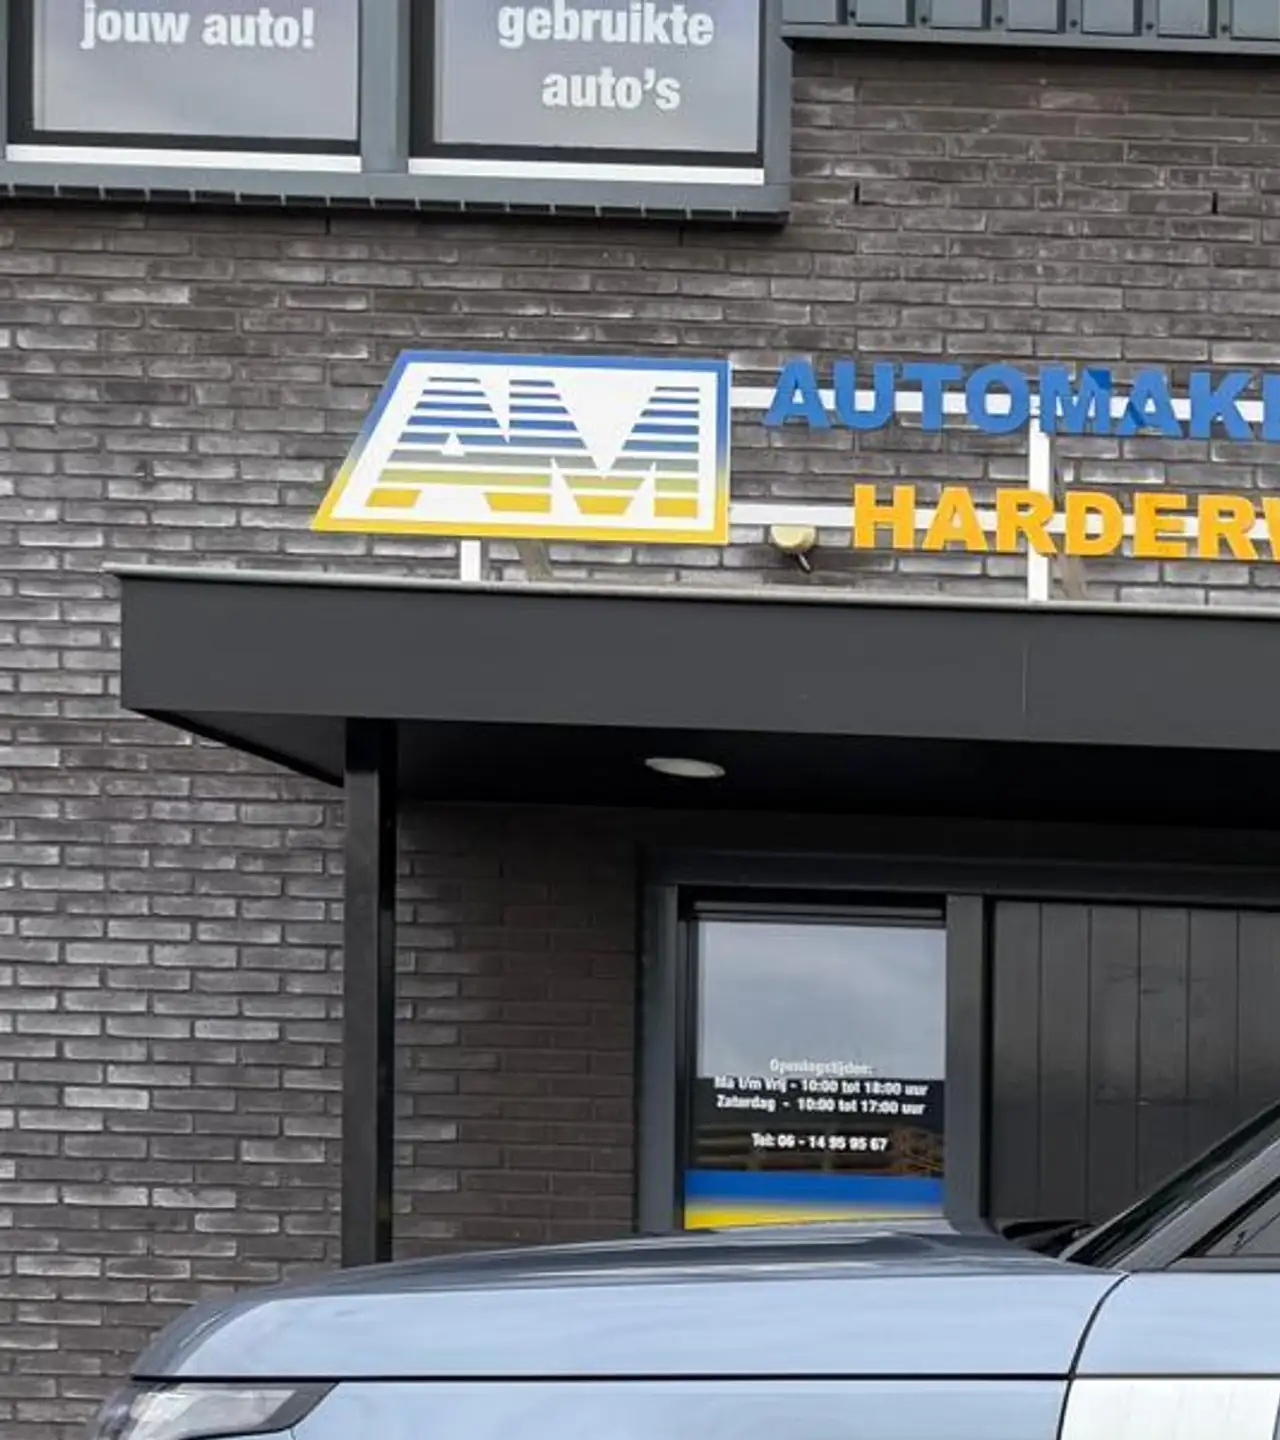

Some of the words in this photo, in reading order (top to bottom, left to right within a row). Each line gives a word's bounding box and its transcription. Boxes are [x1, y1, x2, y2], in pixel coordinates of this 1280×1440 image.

[80, 0, 191, 49] jouw
[201, 7, 316, 49] auto!
[497, 0, 715, 49] gebruikte
